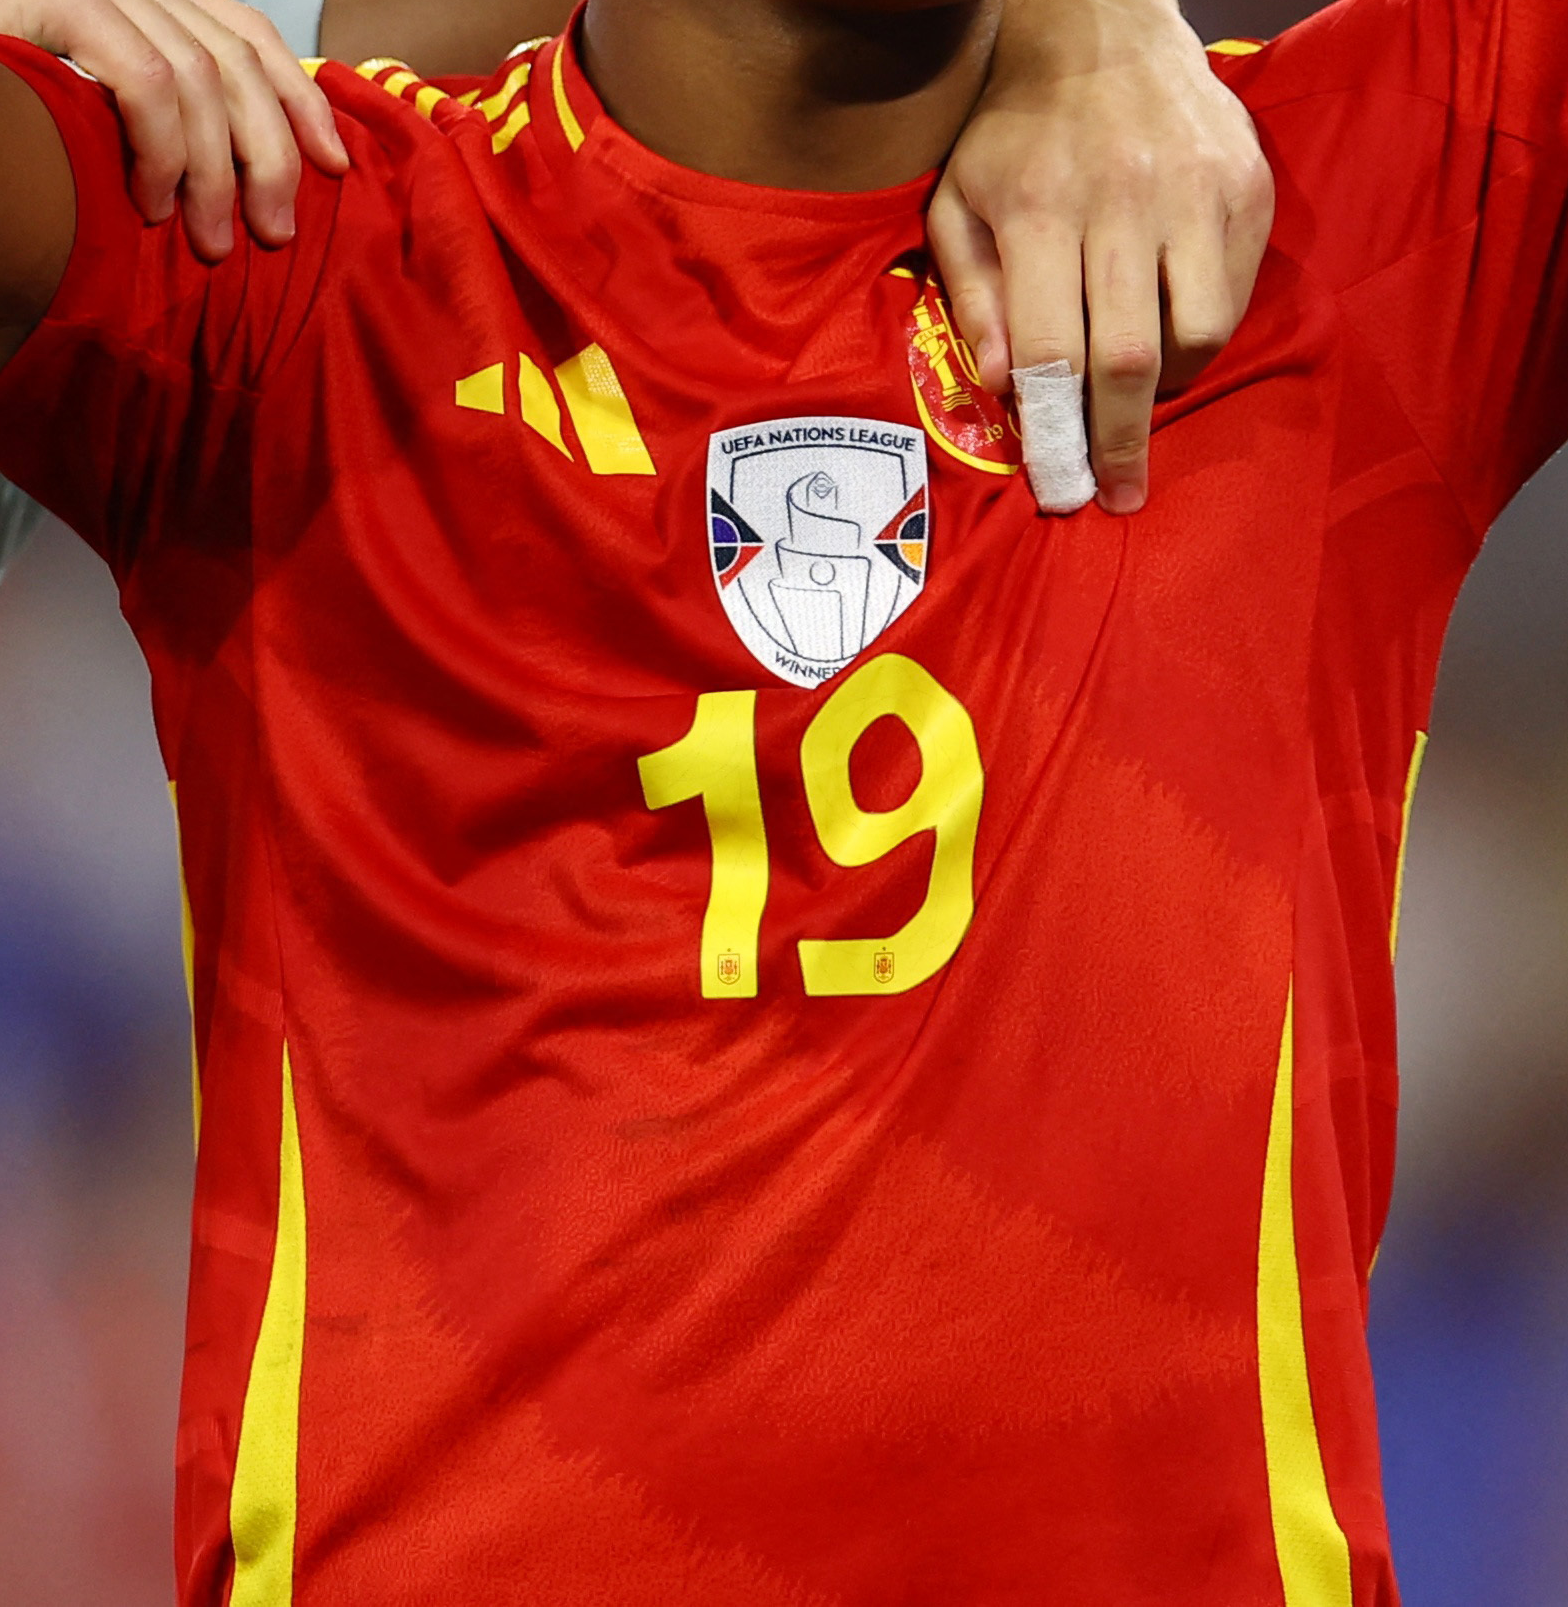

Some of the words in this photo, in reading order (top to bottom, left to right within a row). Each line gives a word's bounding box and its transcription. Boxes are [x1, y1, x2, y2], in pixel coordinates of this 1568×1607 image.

[721, 433, 764, 455] UEFA
[769, 426, 845, 445] NATIONS
[849, 428, 917, 452] LEAGUE
[636, 651, 985, 1000] 19
